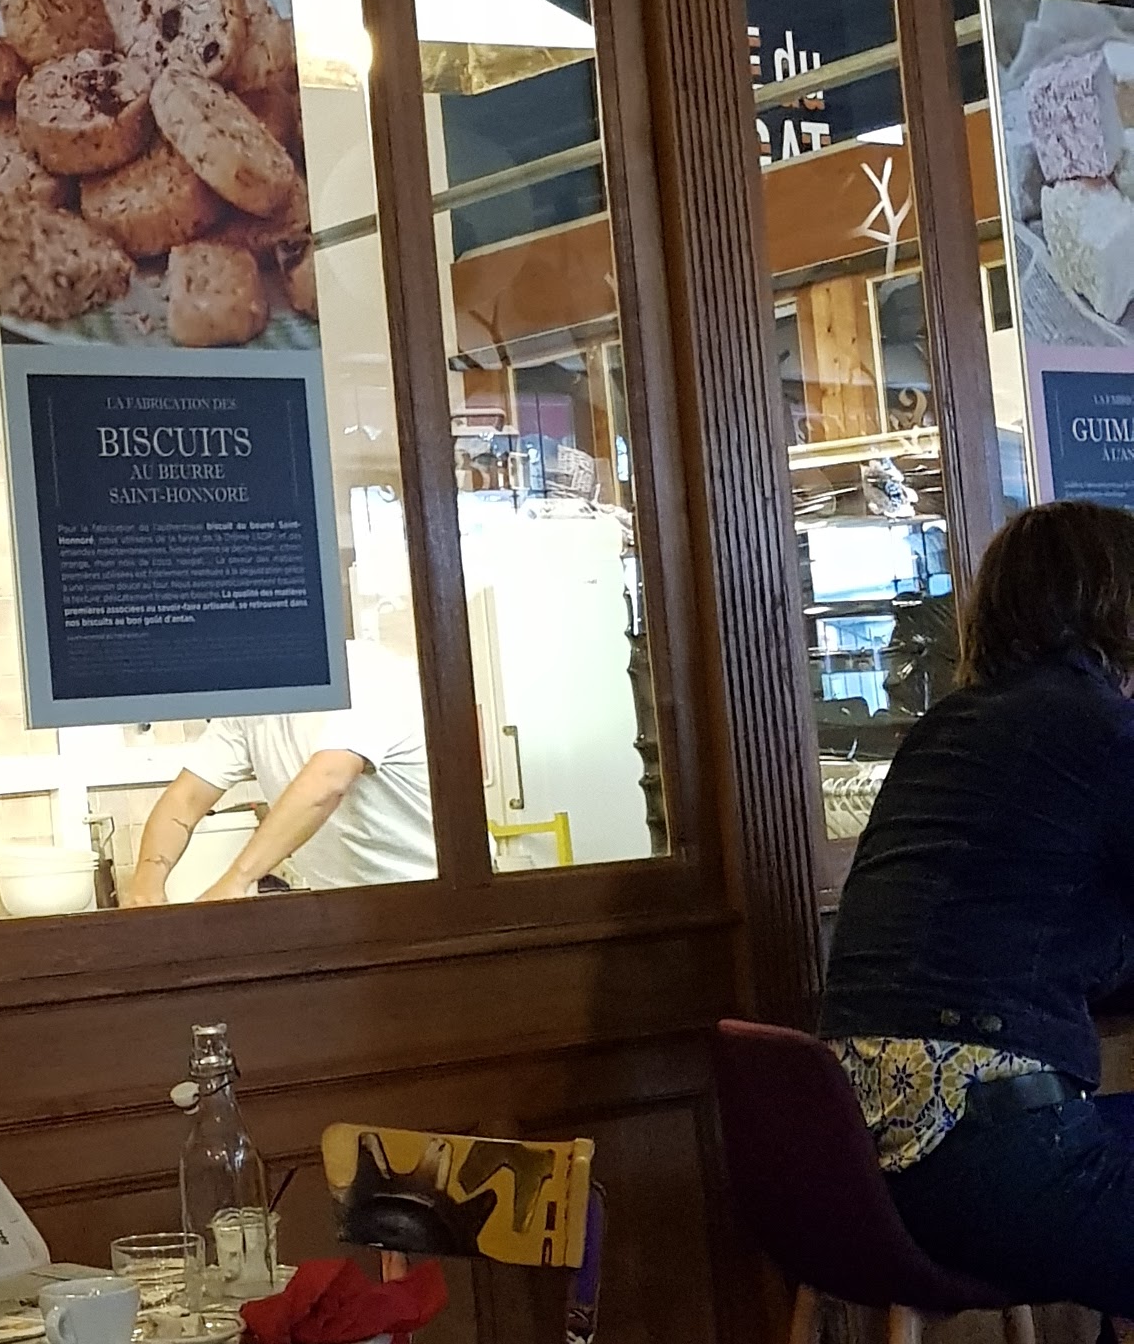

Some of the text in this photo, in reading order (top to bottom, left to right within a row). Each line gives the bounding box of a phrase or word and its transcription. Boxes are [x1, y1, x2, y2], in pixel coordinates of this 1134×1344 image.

[107, 397, 237, 410] LA FABRICATION DES
[1072, 417, 1134, 443] GUIM
[96, 426, 254, 457] BISCUITS
[130, 463, 226, 480] AU BEURRE
[109, 482, 250, 504] SAINT-HONNORÉ
